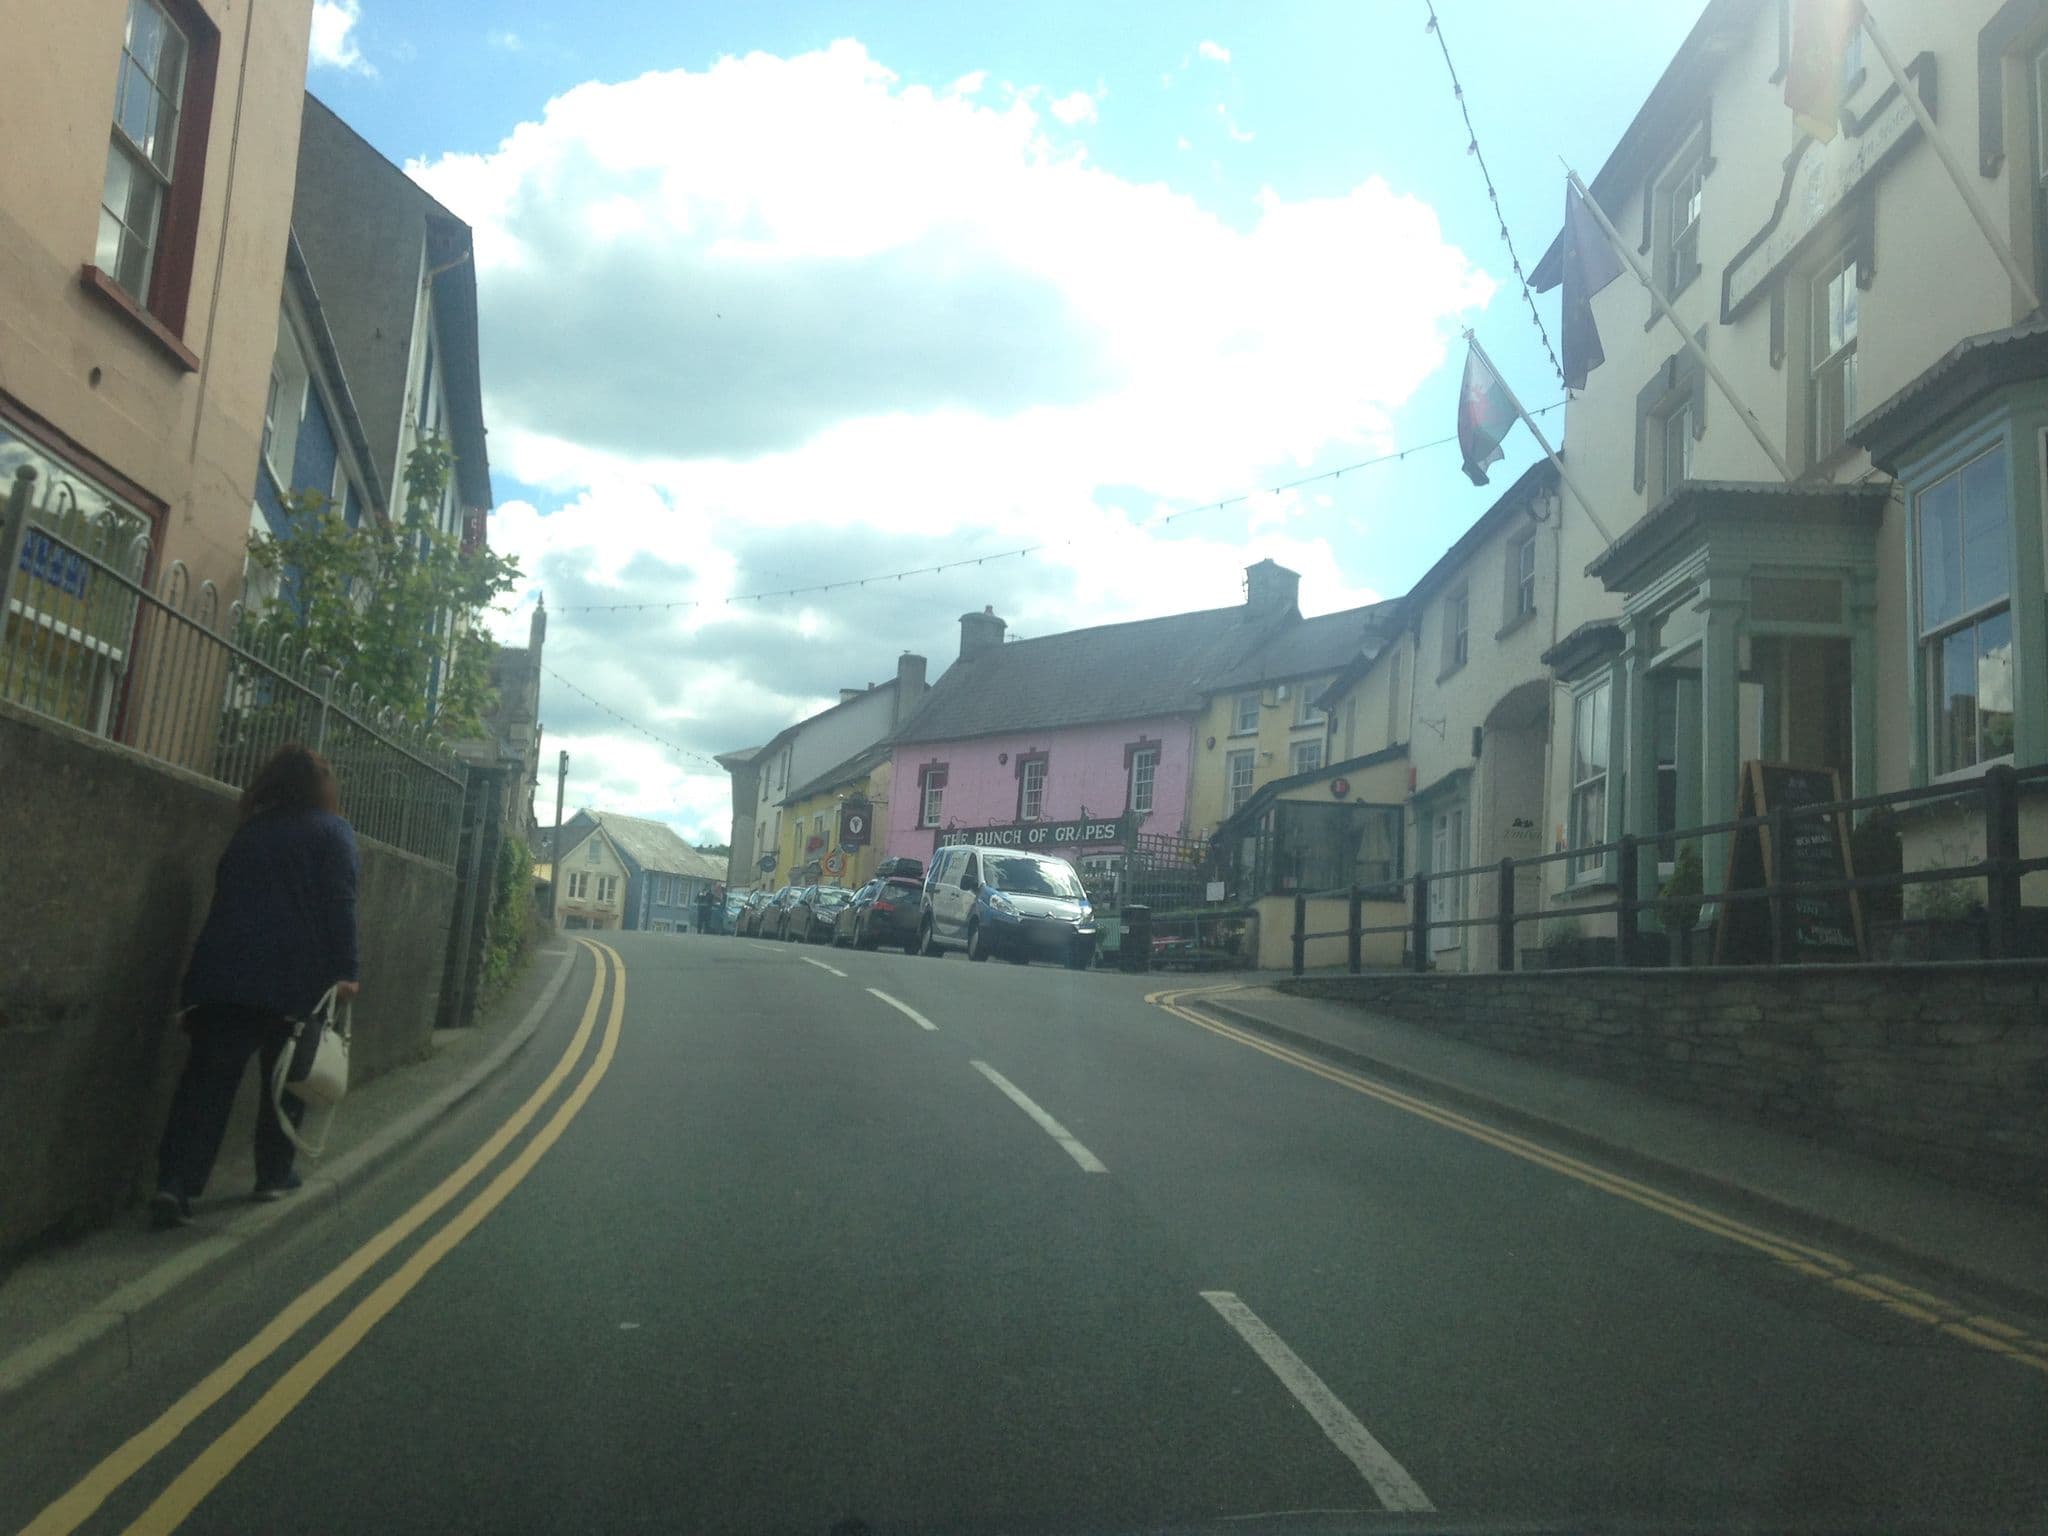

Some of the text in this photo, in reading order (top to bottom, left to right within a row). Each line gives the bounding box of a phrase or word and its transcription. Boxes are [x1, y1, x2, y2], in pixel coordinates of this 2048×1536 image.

[943, 833, 969, 847] THE
[975, 829, 1022, 846] BUNCH
[1028, 828, 1048, 842] OF
